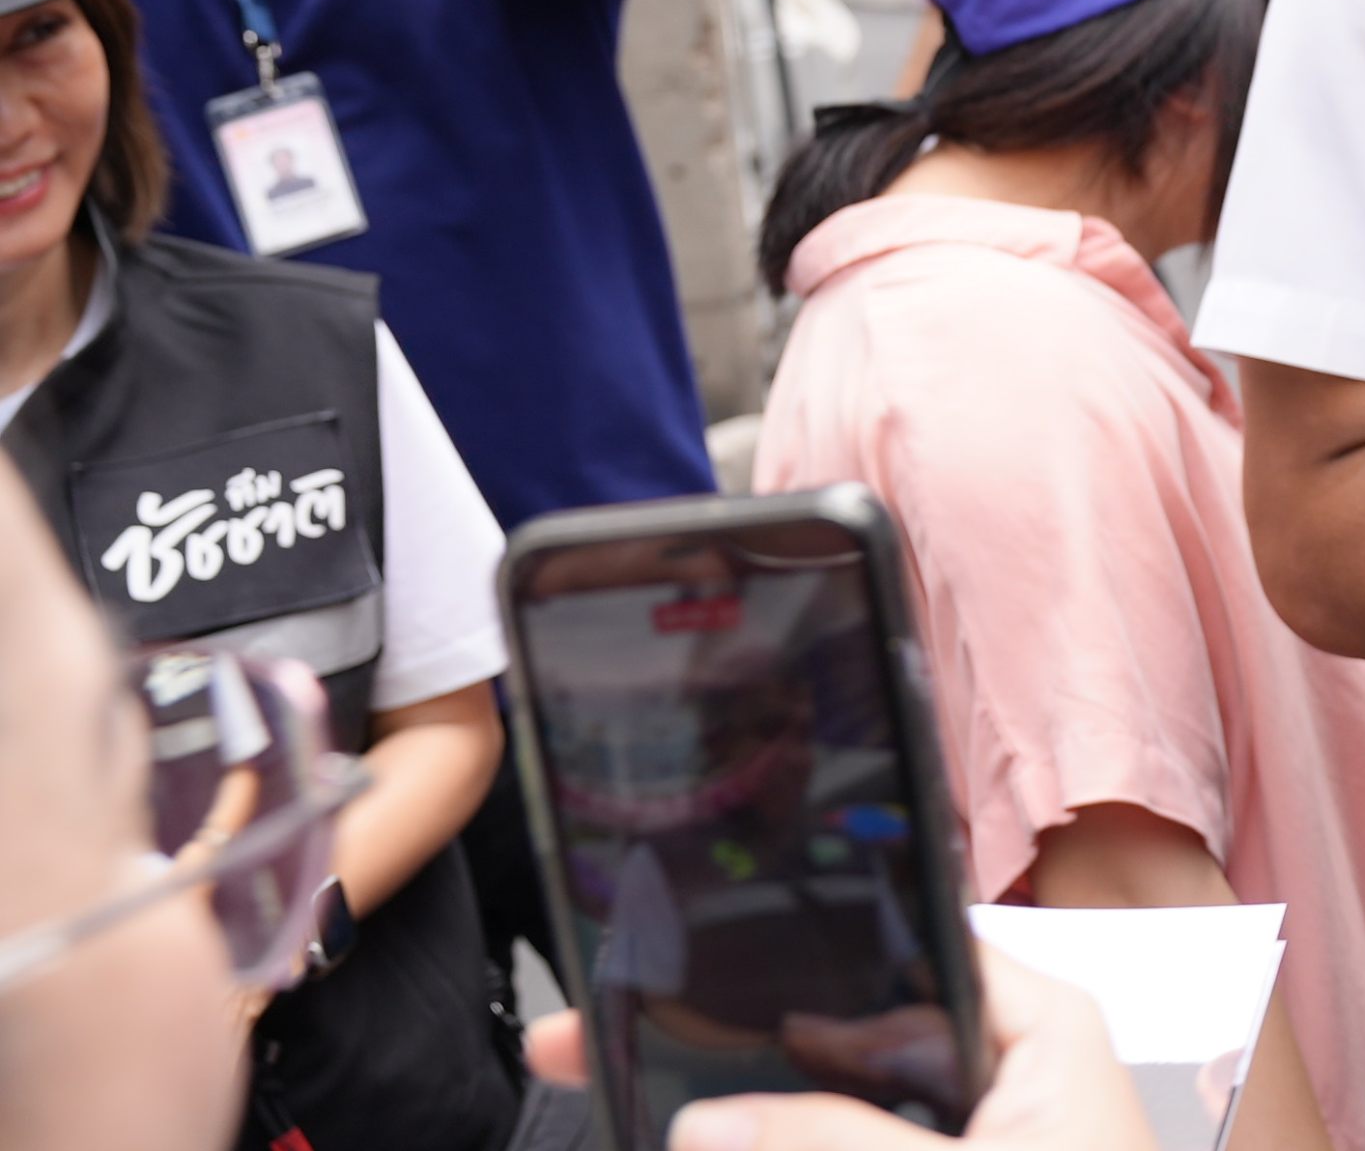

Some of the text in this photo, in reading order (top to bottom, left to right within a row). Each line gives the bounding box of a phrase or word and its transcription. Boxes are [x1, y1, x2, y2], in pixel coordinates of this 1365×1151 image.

[225, 466, 282, 512] ทีม
[100, 467, 347, 603] ชัชชาติ
